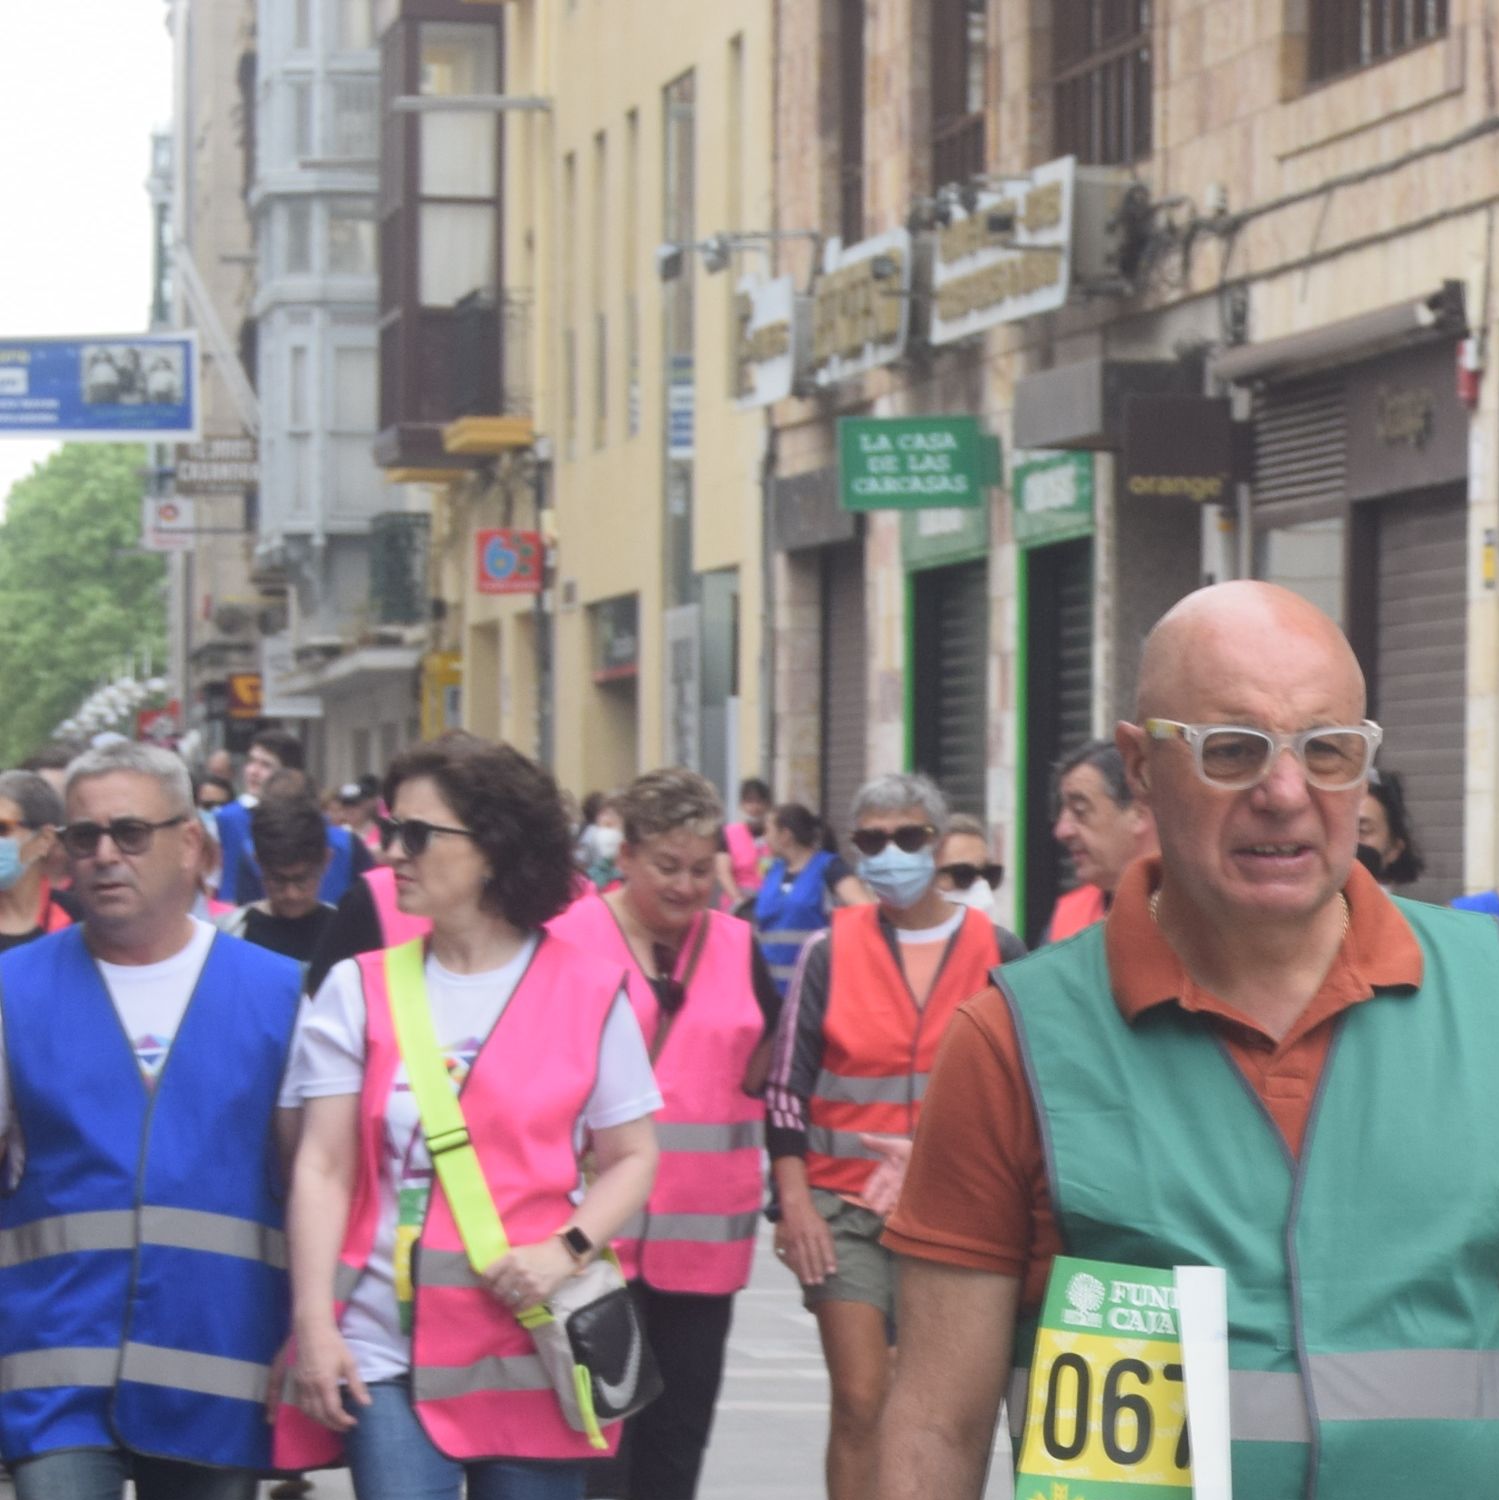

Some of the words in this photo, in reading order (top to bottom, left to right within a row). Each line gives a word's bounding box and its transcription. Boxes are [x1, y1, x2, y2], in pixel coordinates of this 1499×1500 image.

[859, 433, 893, 453] LA
[896, 432, 957, 450] CASA
[867, 454, 898, 473] DE
[907, 453, 950, 473] LAS
[852, 474, 968, 496] CARCASAS
[1129, 474, 1222, 502] orange
[1107, 1306, 1177, 1335] CAJA
